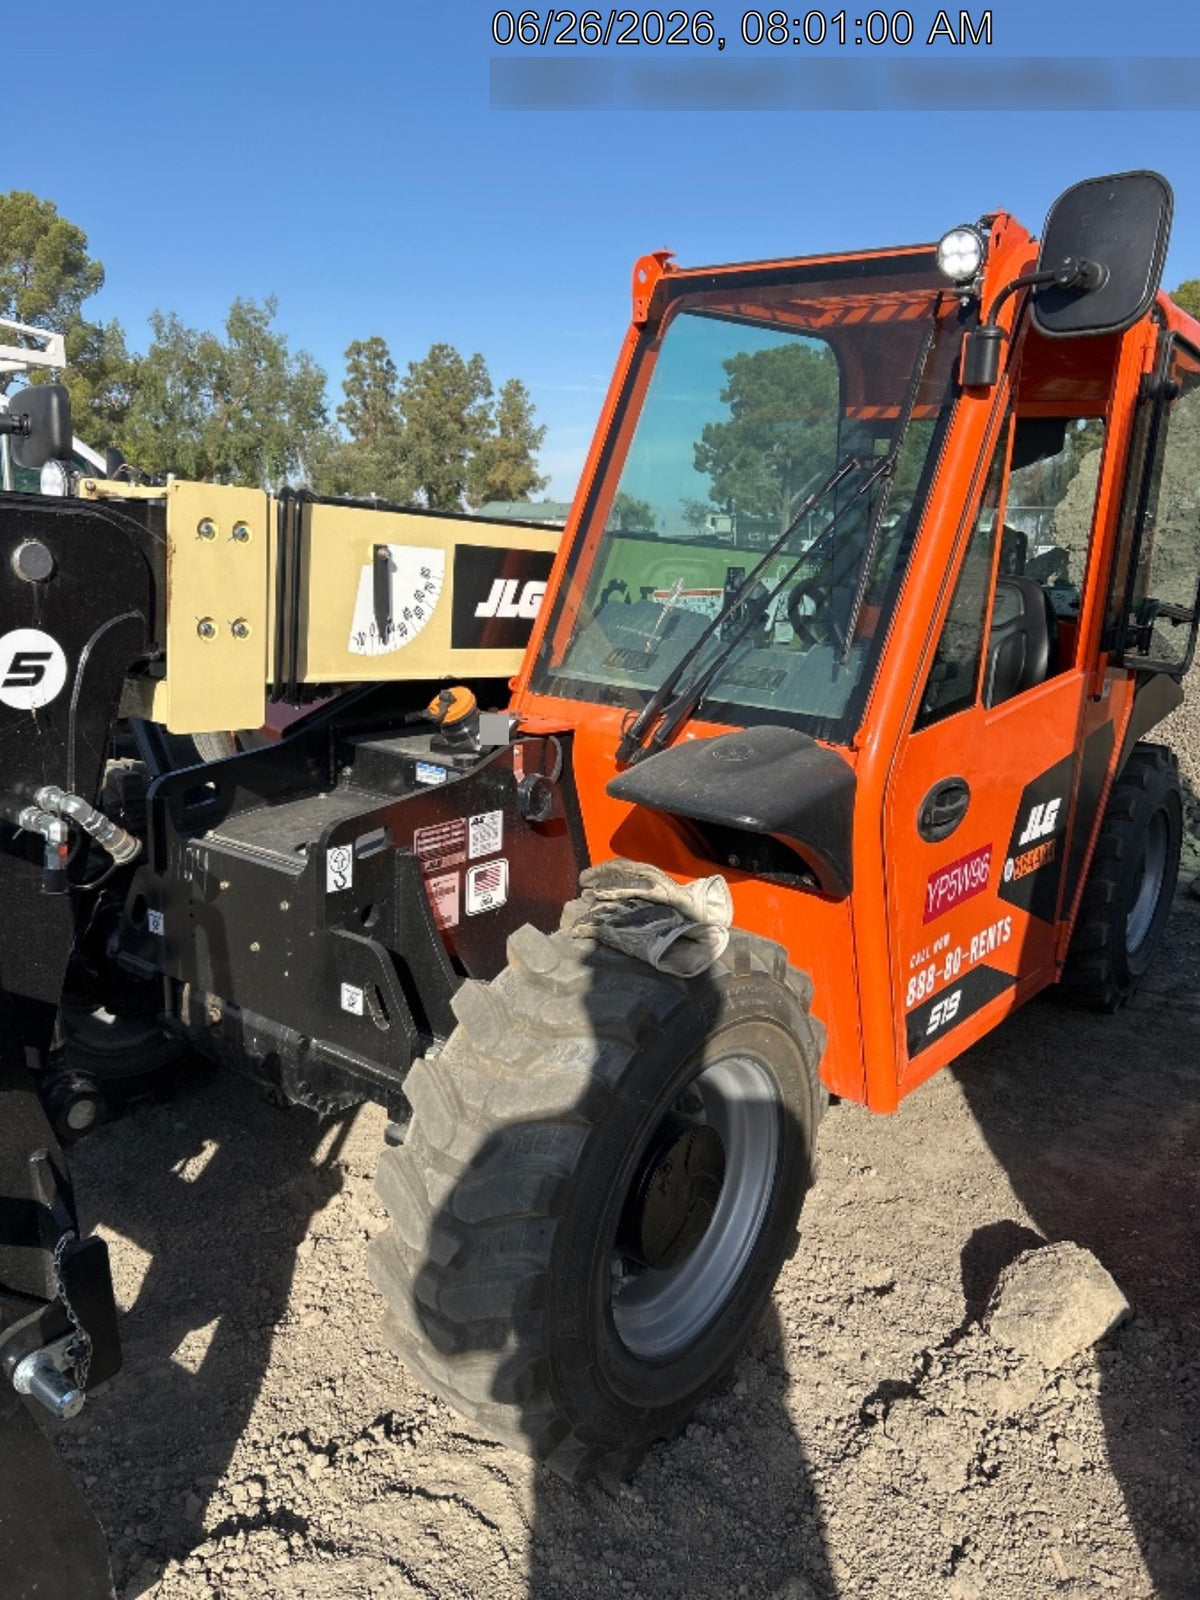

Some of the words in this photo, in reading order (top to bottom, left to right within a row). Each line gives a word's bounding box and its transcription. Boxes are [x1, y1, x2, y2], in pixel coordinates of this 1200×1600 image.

[474, 578, 548, 619] JLG
[2, 652, 53, 688] 5
[1018, 797, 1062, 847] JLG
[928, 853, 989, 913] YP5W96
[906, 916, 1012, 1007] 888-80-RENTS
